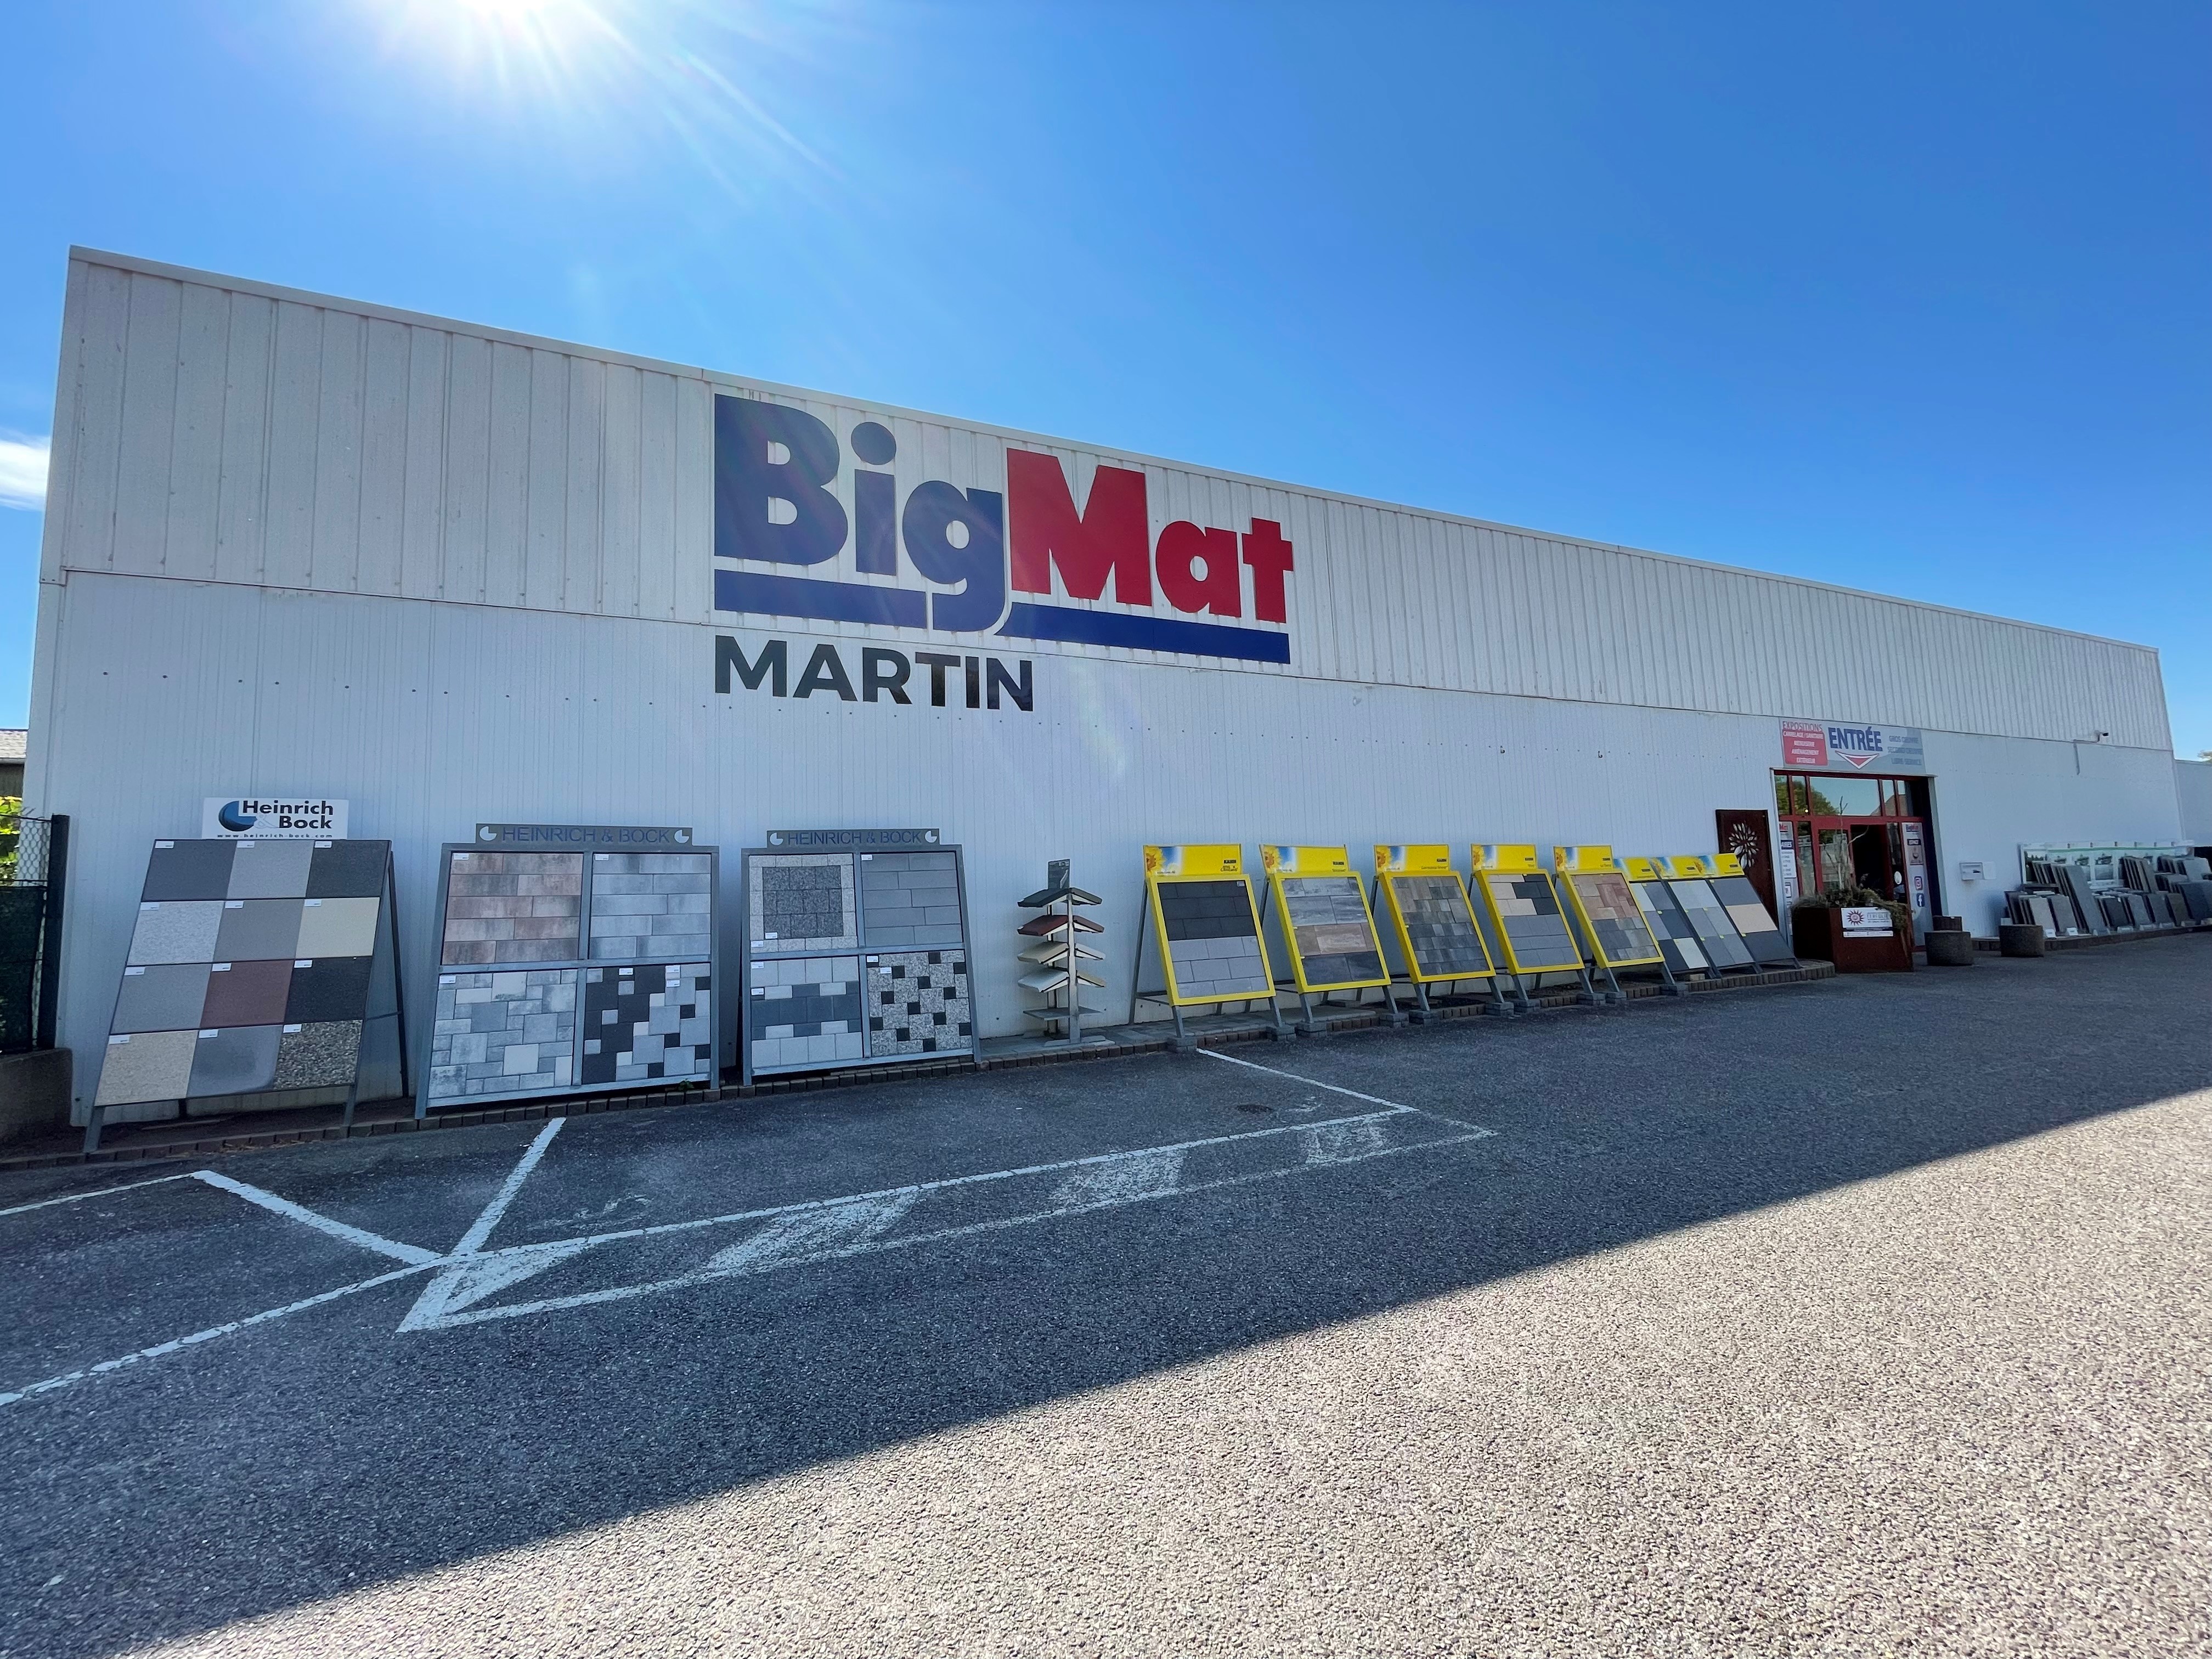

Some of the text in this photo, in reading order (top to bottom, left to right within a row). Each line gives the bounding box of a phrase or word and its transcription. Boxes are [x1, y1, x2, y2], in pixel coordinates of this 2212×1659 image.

[715, 393, 1294, 631] BigMat
[715, 635, 1034, 712] MARTIN
[1782, 721, 1822, 732] EXPOSITIONS
[1828, 726, 1883, 751] ENTRÉE
[242, 800, 333, 815] Heinrich
[279, 815, 332, 829] Bock
[502, 827, 670, 843] HEINRICH & BOCK
[788, 831, 922, 845] HEINRICH & BOCK
